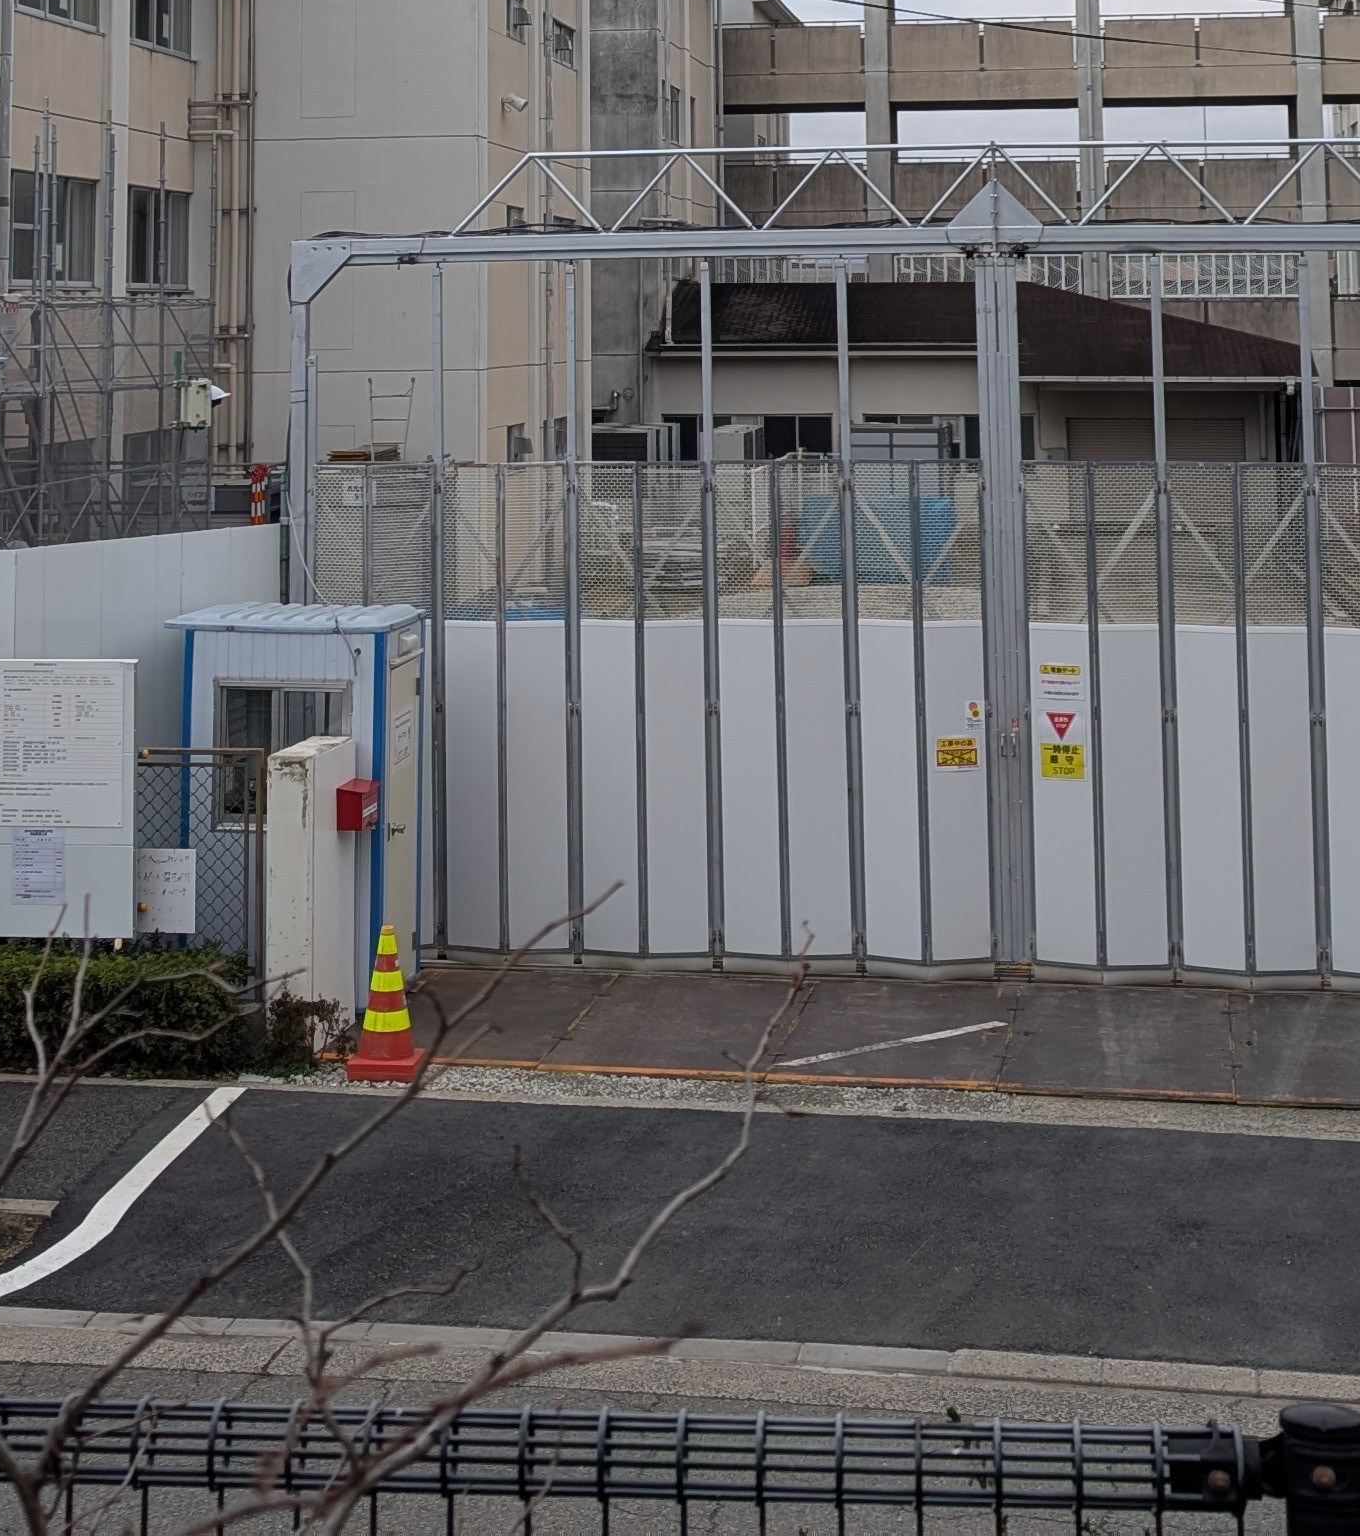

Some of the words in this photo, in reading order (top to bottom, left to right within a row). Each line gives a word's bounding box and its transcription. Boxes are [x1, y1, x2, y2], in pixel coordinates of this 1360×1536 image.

[1043, 744, 1080, 755] 一時停止
[1052, 766, 1076, 775] STOP
